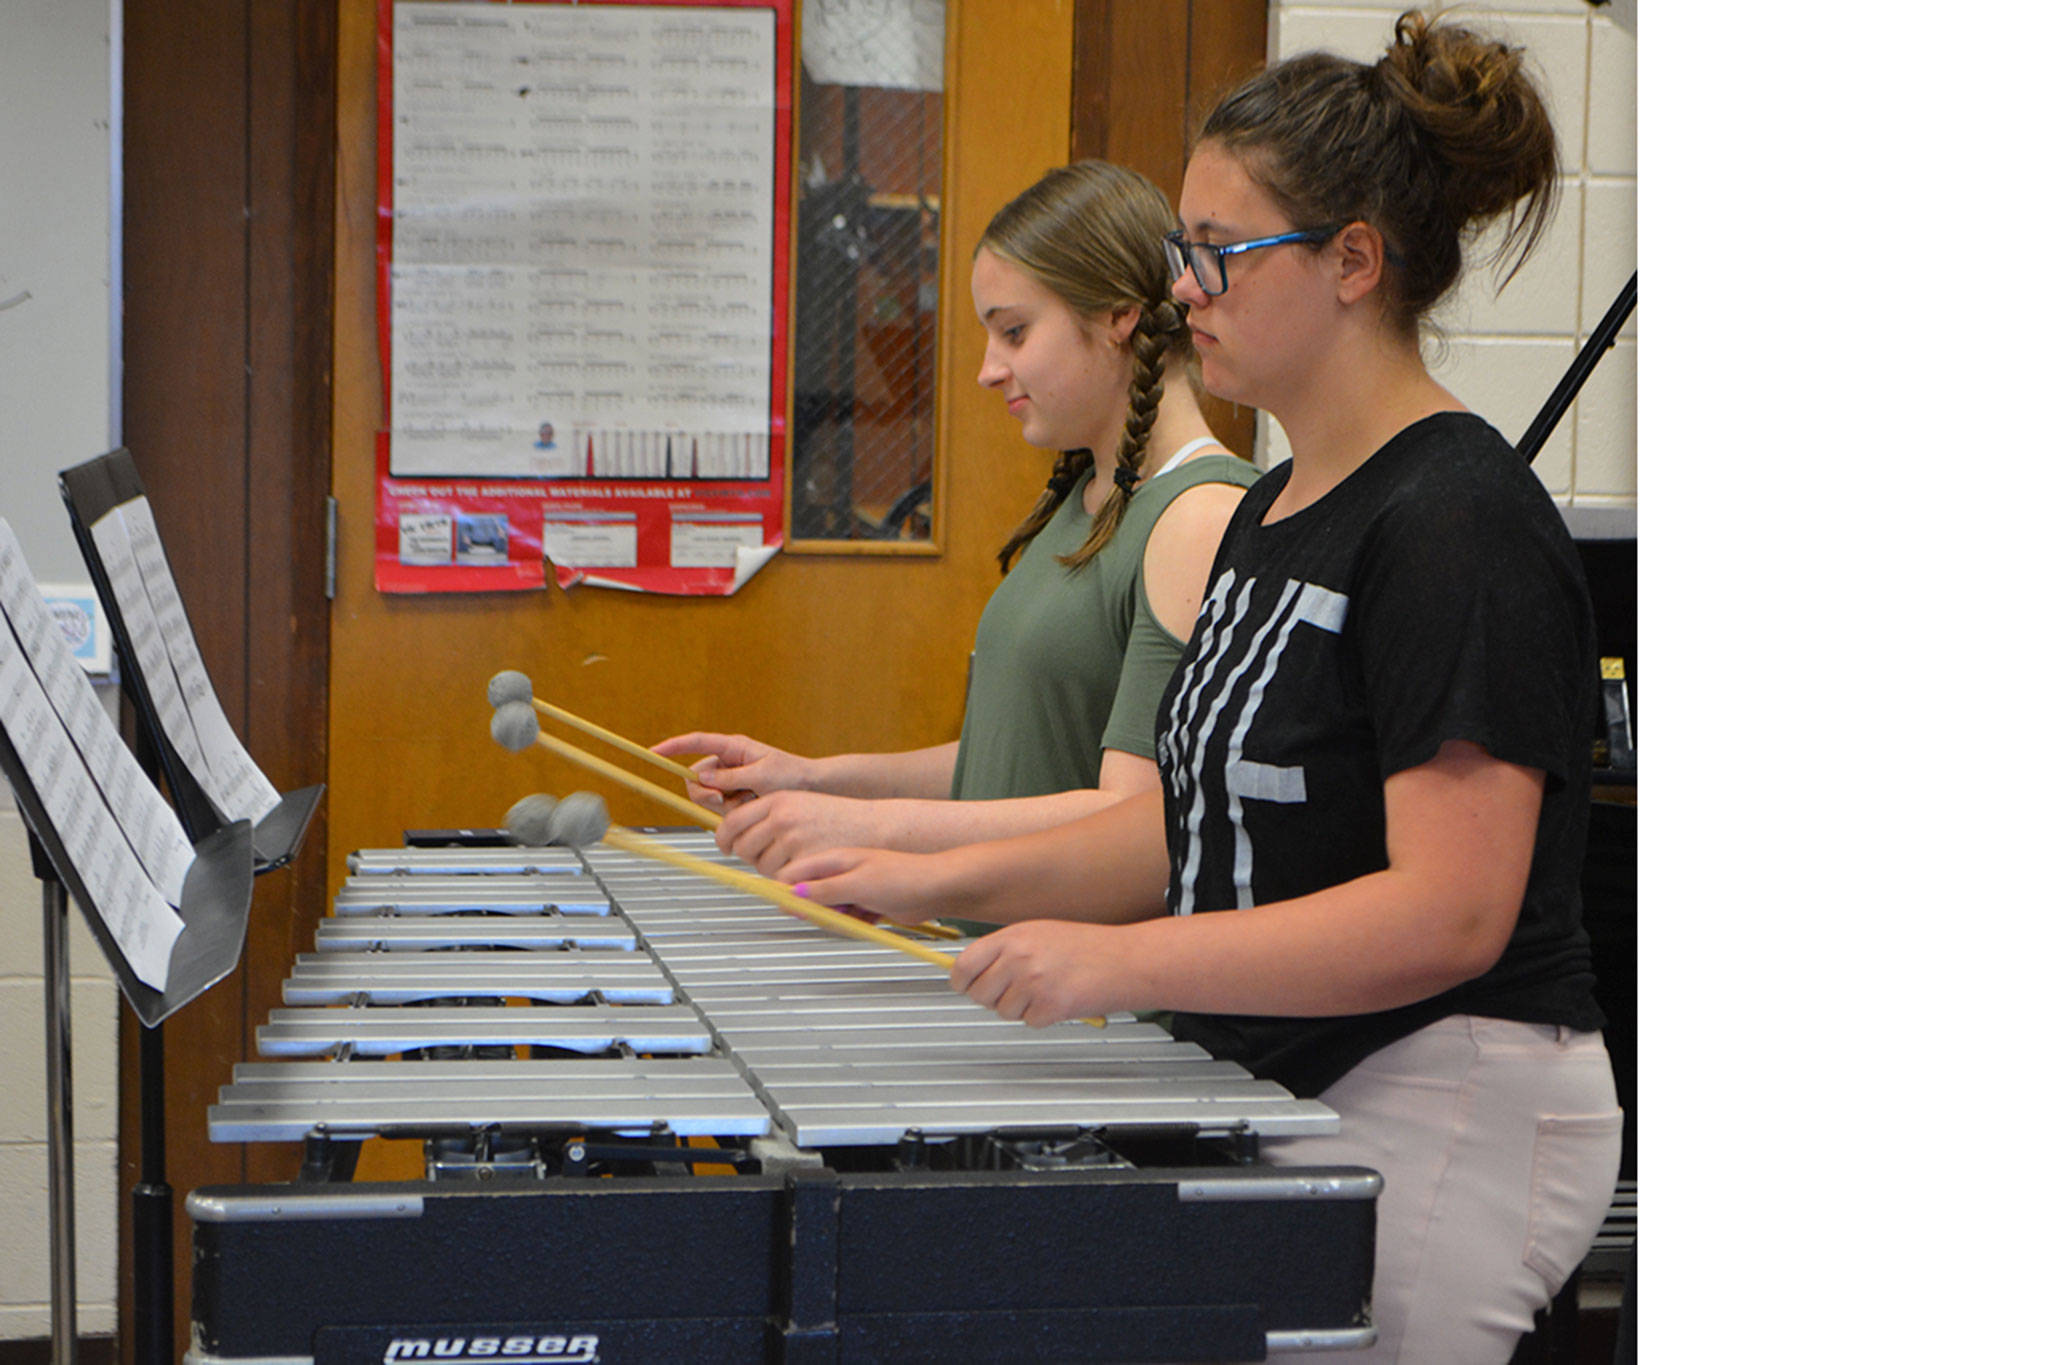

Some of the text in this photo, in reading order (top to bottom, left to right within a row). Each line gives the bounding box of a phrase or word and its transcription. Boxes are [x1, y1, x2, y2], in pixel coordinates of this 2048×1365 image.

[430, 487, 453, 498] OUT
[456, 487, 478, 498] THE
[482, 487, 547, 498] ADDITIONAL
[550, 487, 612, 498] MATERIALS
[615, 488, 673, 499] AVAILABLE
[676, 488, 692, 499] AT
